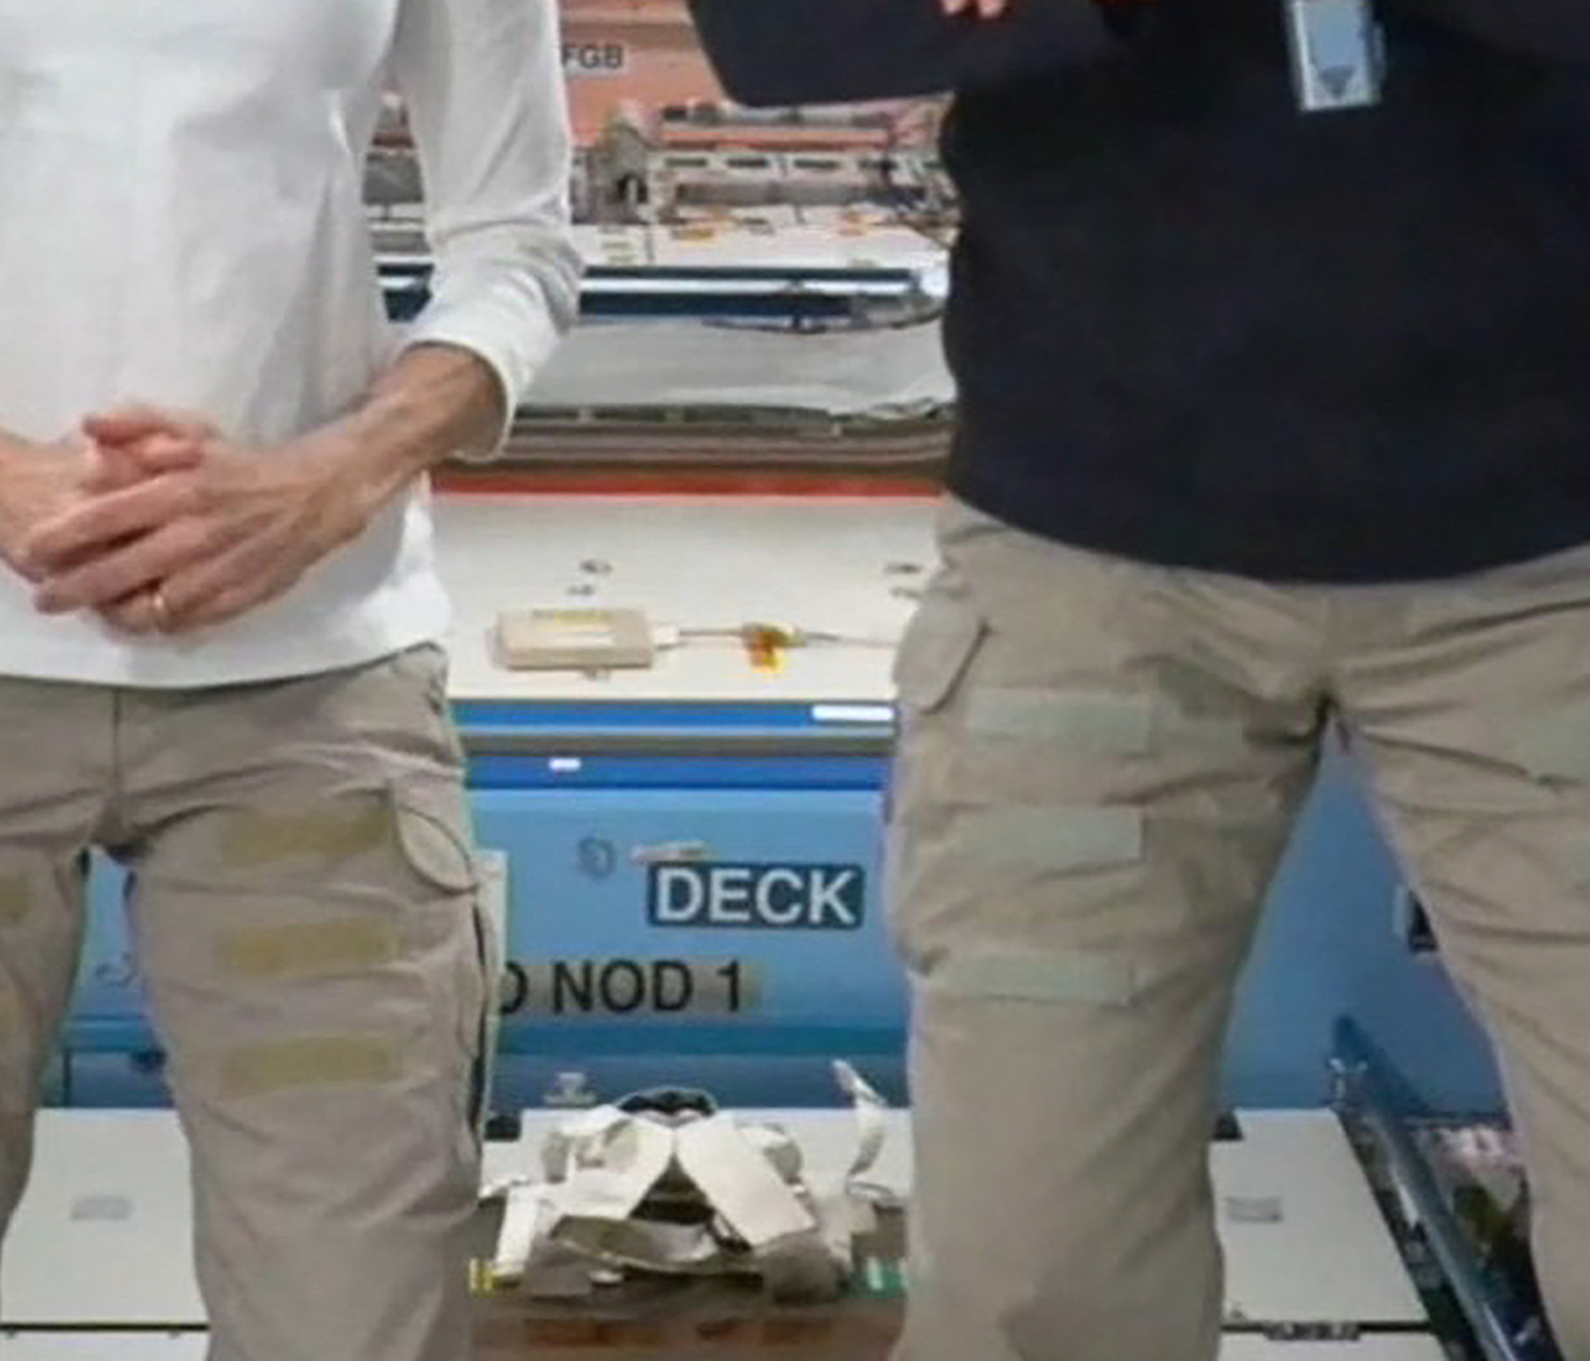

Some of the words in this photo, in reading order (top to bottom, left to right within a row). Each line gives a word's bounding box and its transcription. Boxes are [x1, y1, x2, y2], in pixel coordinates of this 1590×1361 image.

[656, 867, 856, 926] DECK
[552, 959, 694, 1014] NOD
[716, 959, 740, 1012] 1
